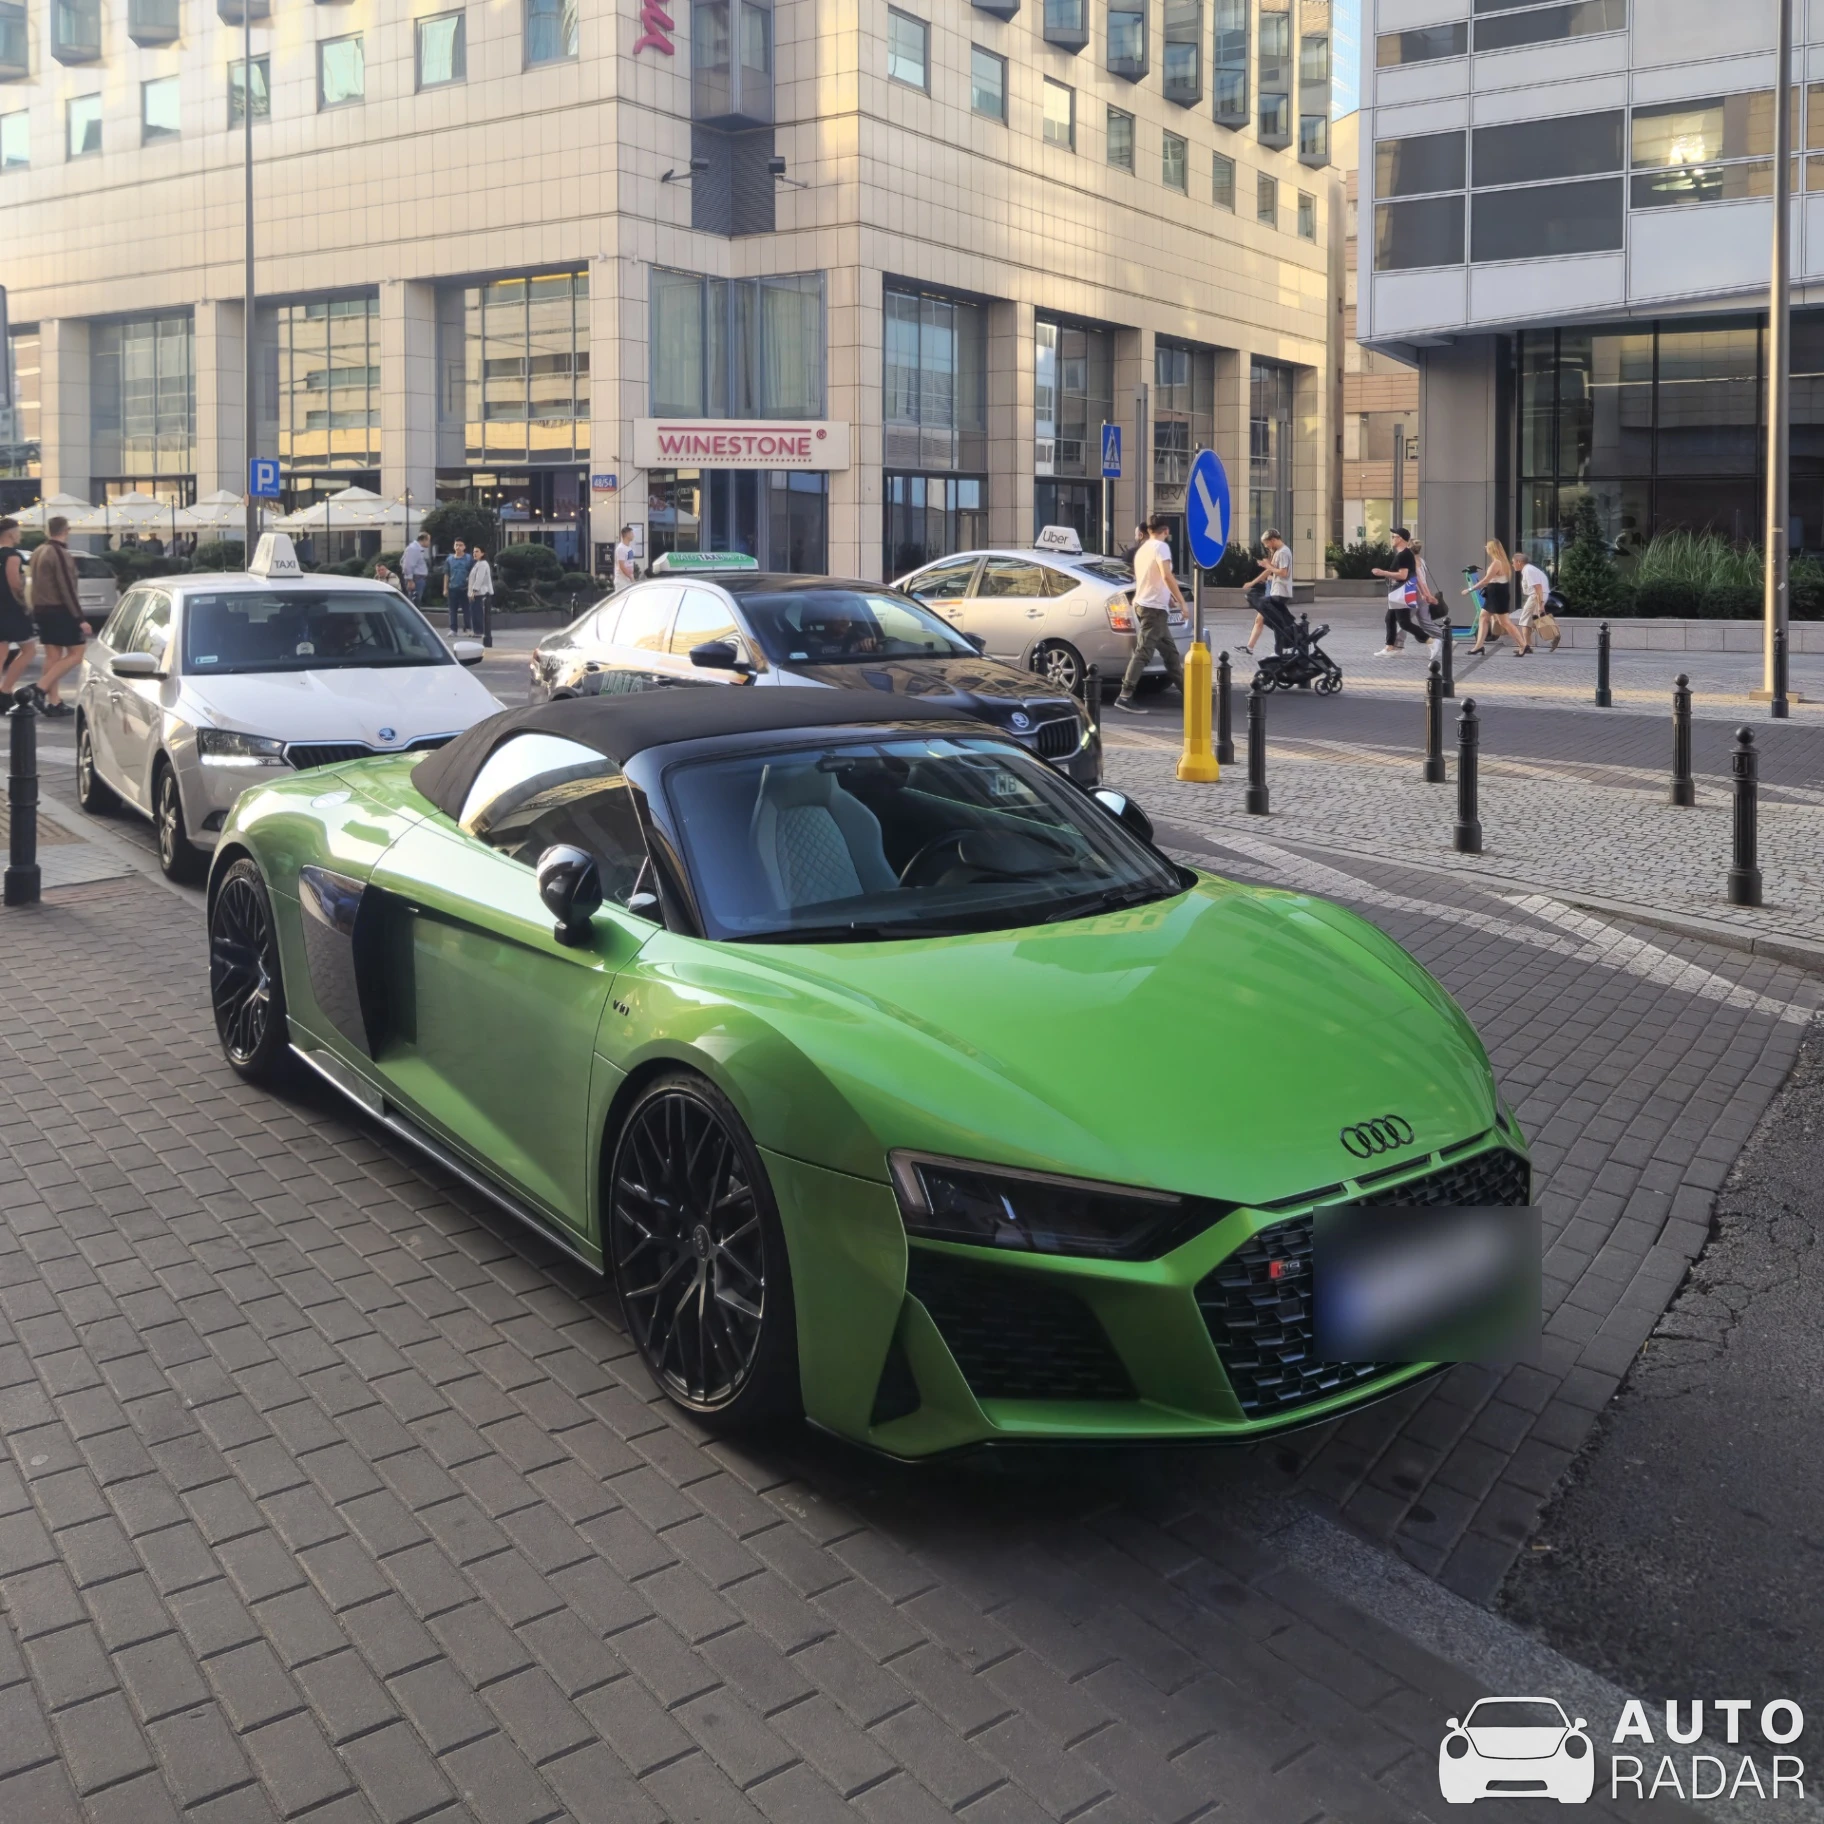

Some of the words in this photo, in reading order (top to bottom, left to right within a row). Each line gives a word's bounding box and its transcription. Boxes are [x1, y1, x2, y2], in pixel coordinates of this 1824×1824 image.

[658, 435, 812, 456] WINESTONE
[257, 463, 274, 492] P
[594, 478, 613, 488] 48/54
[1042, 530, 1069, 545] Uber
[274, 560, 296, 569] TAXI
[613, 999, 630, 1016] V10
